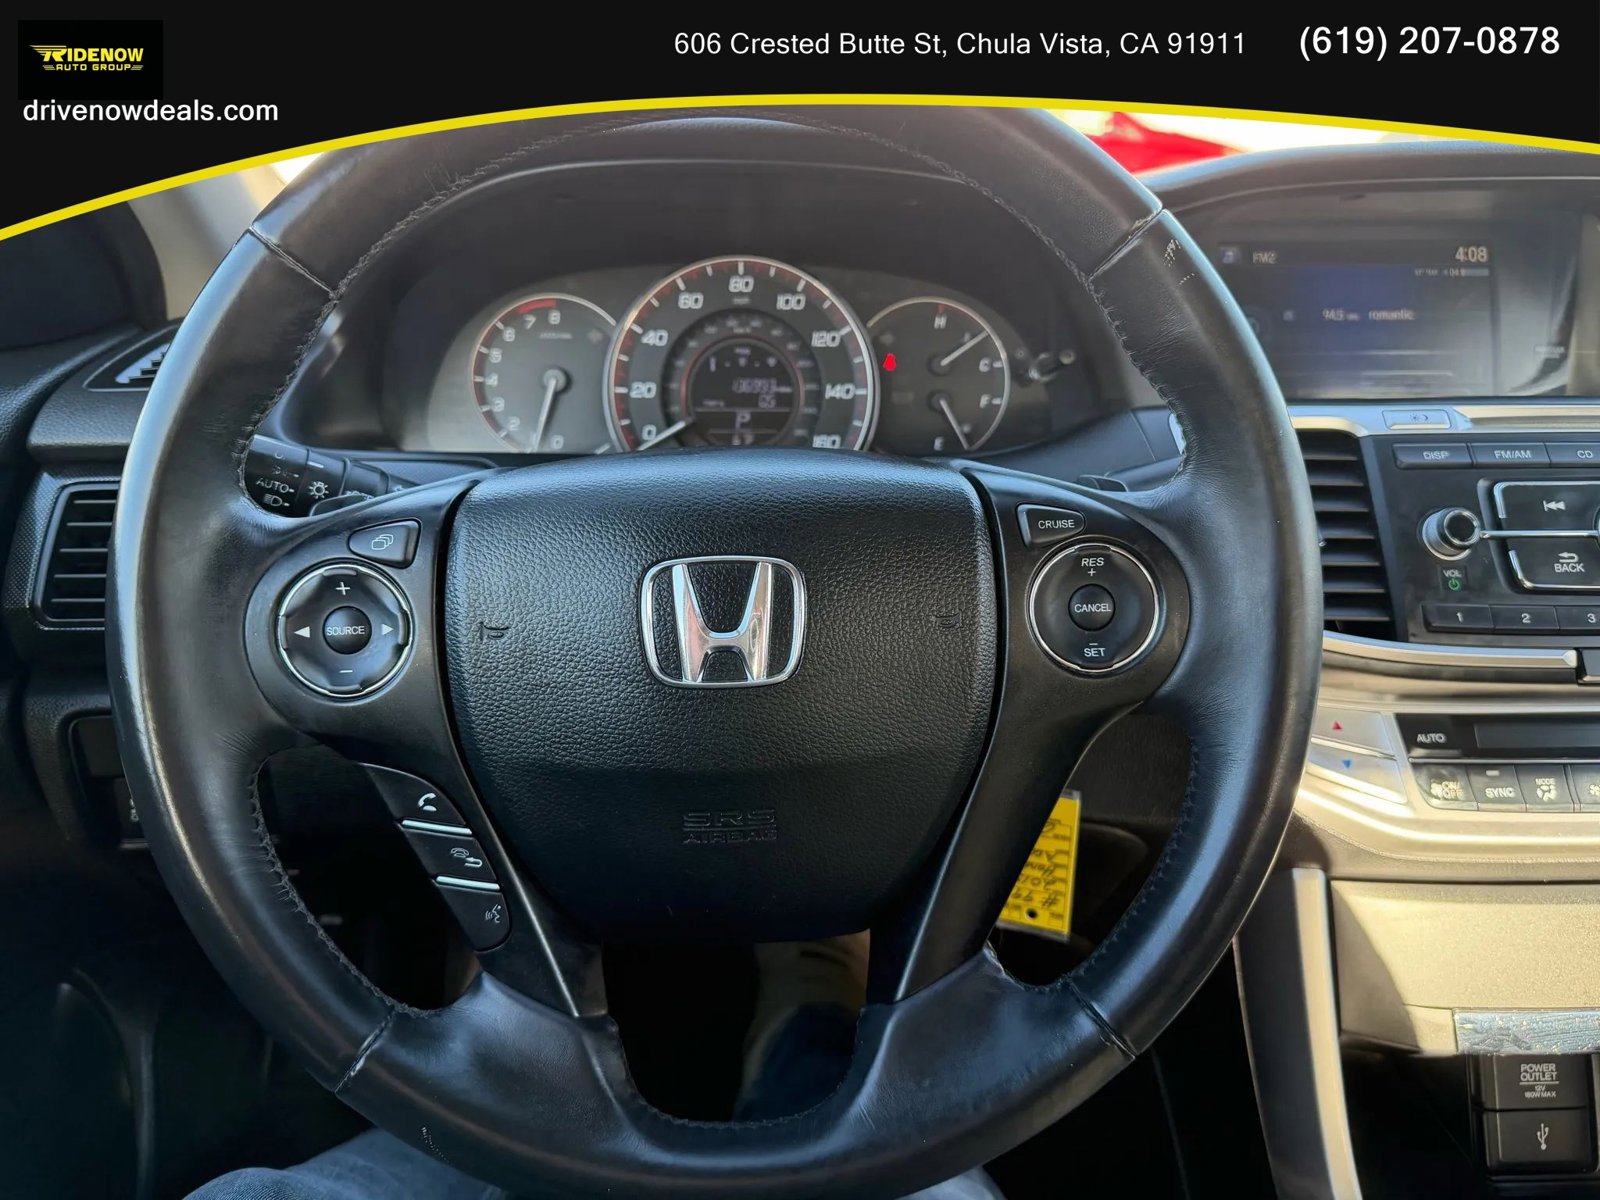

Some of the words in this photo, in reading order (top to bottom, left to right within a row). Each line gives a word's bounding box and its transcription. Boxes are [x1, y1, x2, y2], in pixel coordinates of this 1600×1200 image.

[1455, 245, 1488, 263] 4:08
[728, 276, 754, 292] 80
[678, 292, 704, 309] 60
[776, 295, 806, 310] 100
[524, 316, 537, 329] 7
[933, 314, 947, 329] H
[641, 330, 668, 346] 40
[811, 331, 841, 347] 120
[629, 382, 657, 399] 20
[825, 384, 856, 400] 140
[506, 416, 521, 432] 2
[550, 434, 564, 450] 0
[1422, 451, 1449, 461] DISP
[1493, 449, 1532, 460] FM/AM
[1576, 449, 1594, 460] CD
[255, 476, 290, 494] AUTO
[1037, 519, 1076, 530] CRUISE
[1081, 557, 1105, 568] RES
[1553, 563, 1585, 574] BACK
[1442, 569, 1462, 578] VOL
[1074, 602, 1113, 614] CANCEL
[1456, 611, 1464, 623] 1
[1521, 612, 1532, 624] 2
[1586, 612, 1597, 624] 3
[326, 624, 366, 636] SOURCE
[1083, 647, 1106, 658] SET
[1416, 732, 1447, 744] AUTO
[1535, 777, 1556, 786] MODE
[1485, 786, 1516, 799] SYNC
[682, 809, 776, 828] SRS
[682, 825, 778, 844] AIRBAG
[1520, 1063, 1556, 1072] POWER
[1520, 1071, 1558, 1082] OUTLET
[1541, 1090, 1557, 1098] MAX
